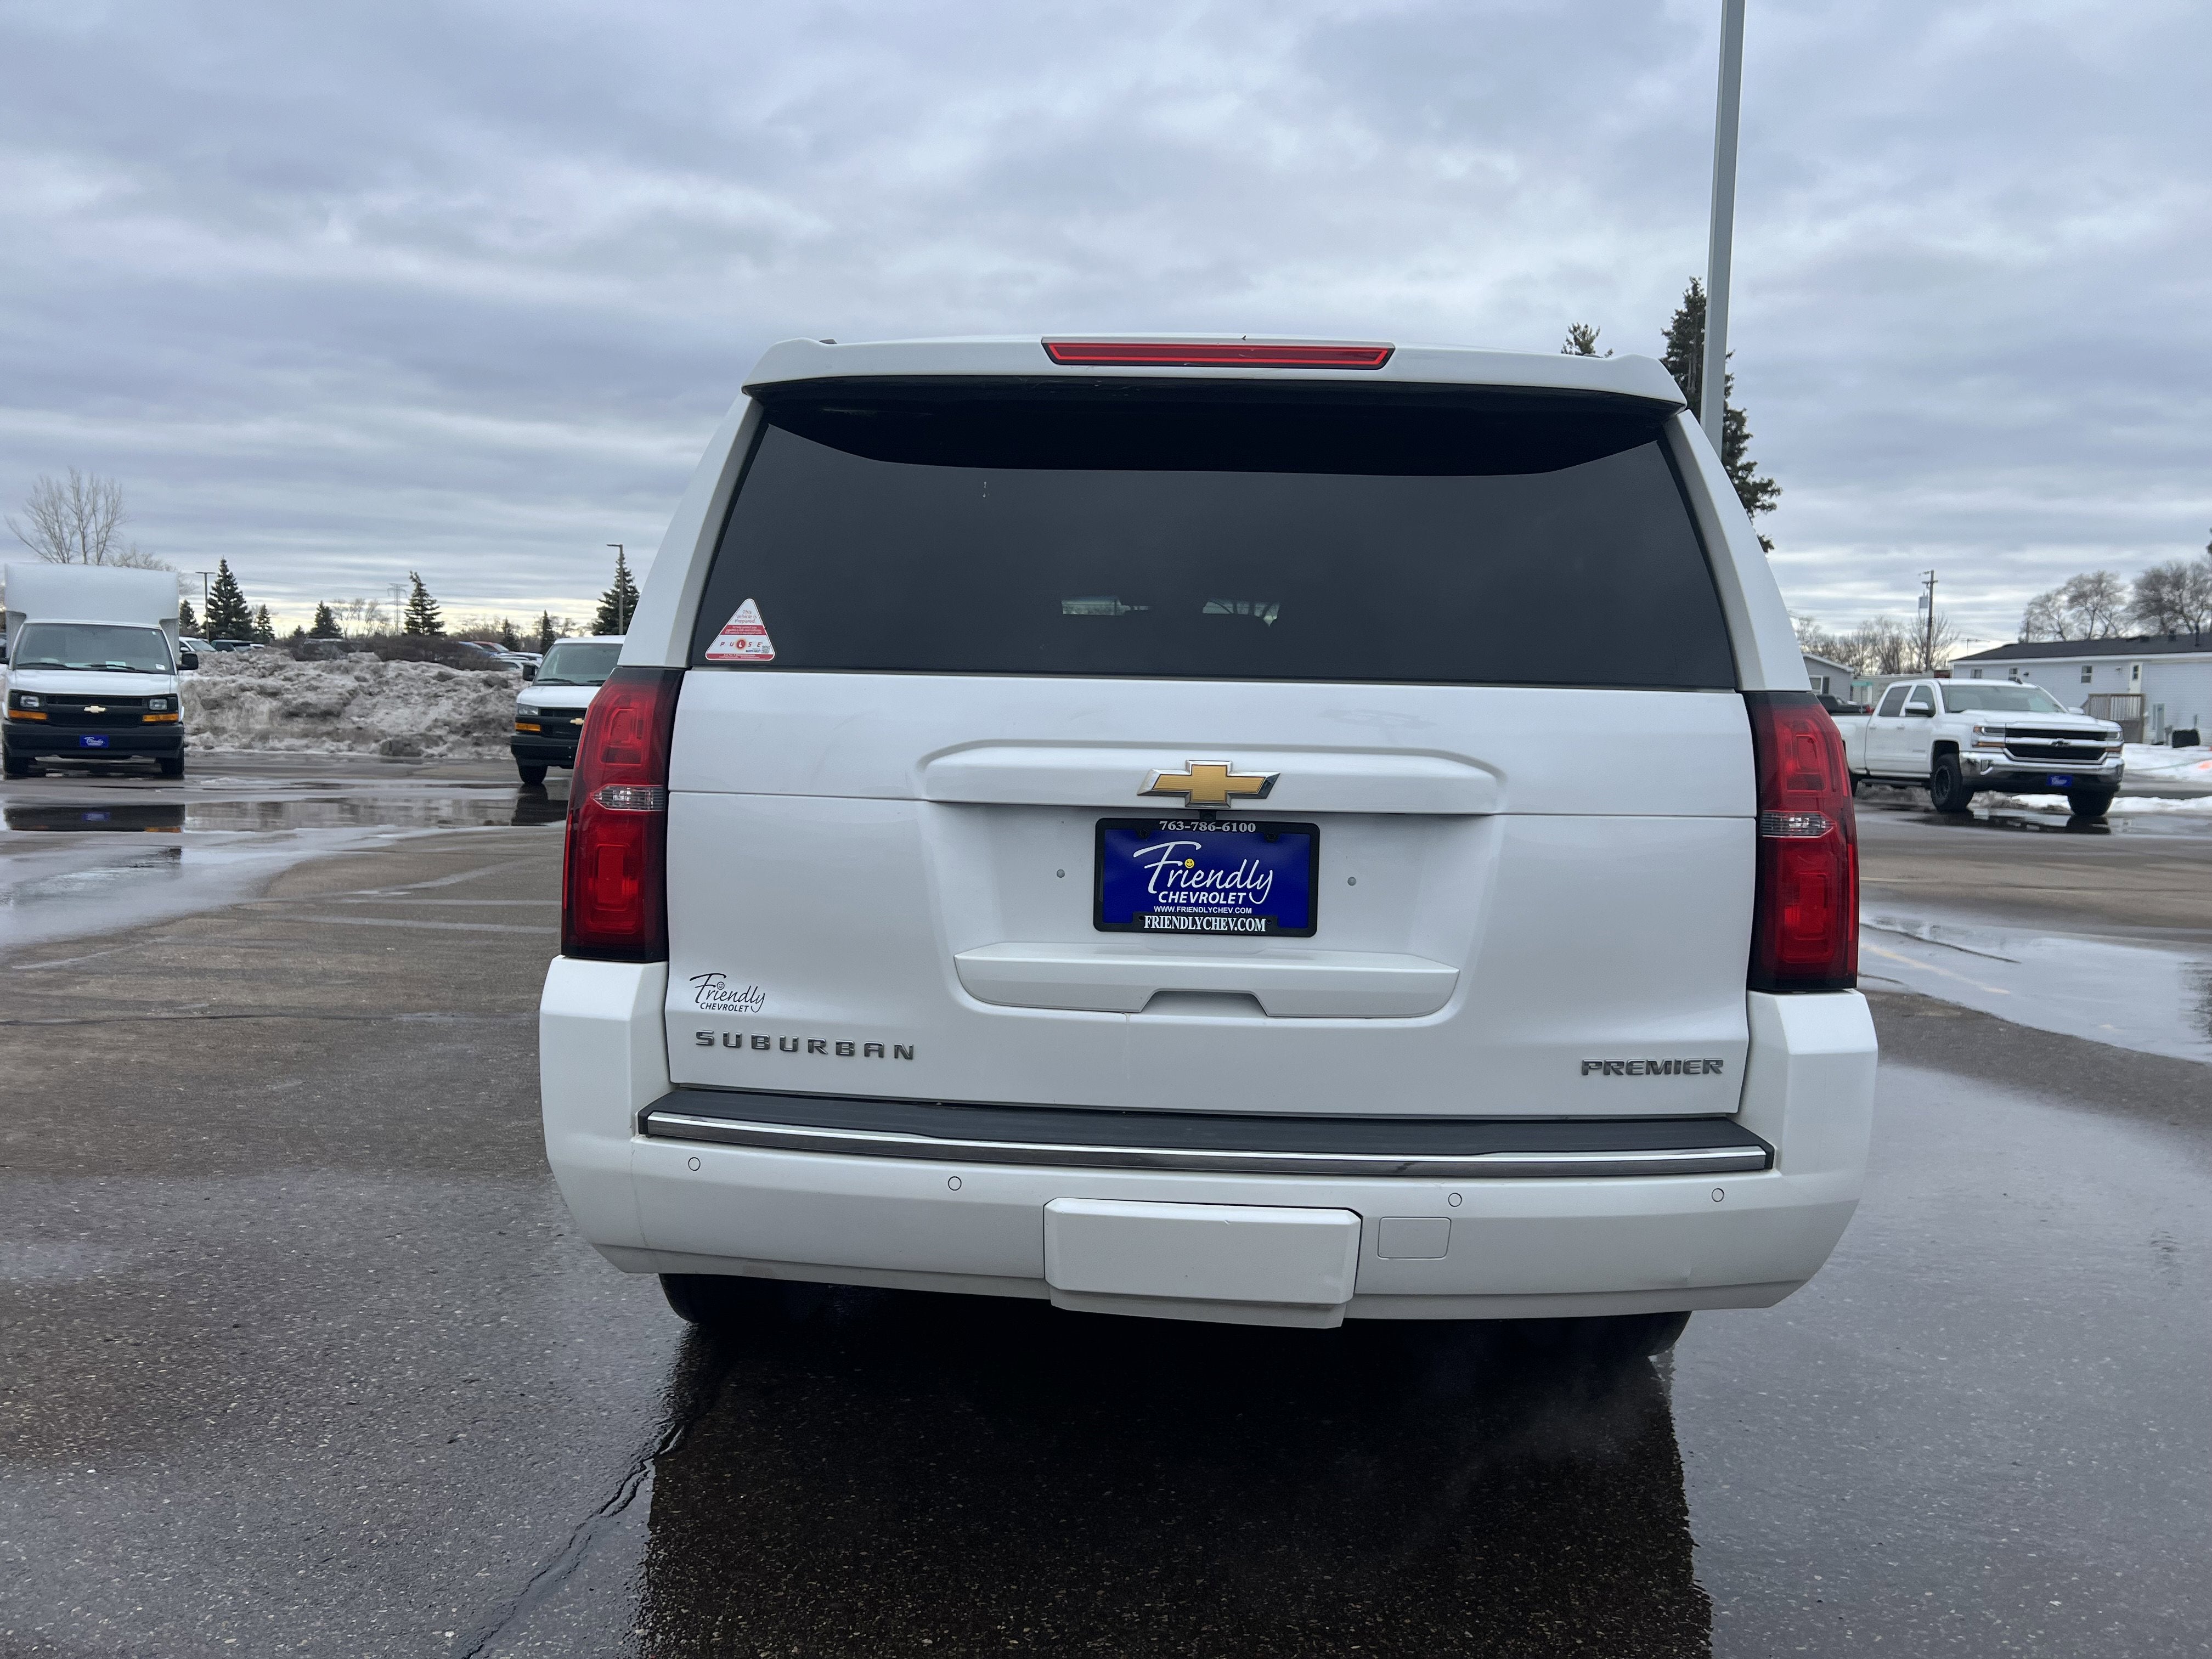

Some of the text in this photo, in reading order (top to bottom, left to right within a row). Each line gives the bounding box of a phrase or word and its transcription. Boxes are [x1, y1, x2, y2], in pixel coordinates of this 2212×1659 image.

[1159, 821, 1256, 833] 763-786-6100
[1133, 840, 1273, 905] Friendly
[1158, 891, 1247, 905] CHEVROLET
[1154, 906, 1252, 915] WWW.FRIENDLYCHEV.COM
[1144, 915, 1266, 932] FRIENDLYCHEV.COM
[689, 973, 765, 1013] Friendly
[699, 1002, 750, 1013] CHEVROLET
[696, 1029, 915, 1060] SUBURBAN
[1581, 1057, 1724, 1076] PREMIER
